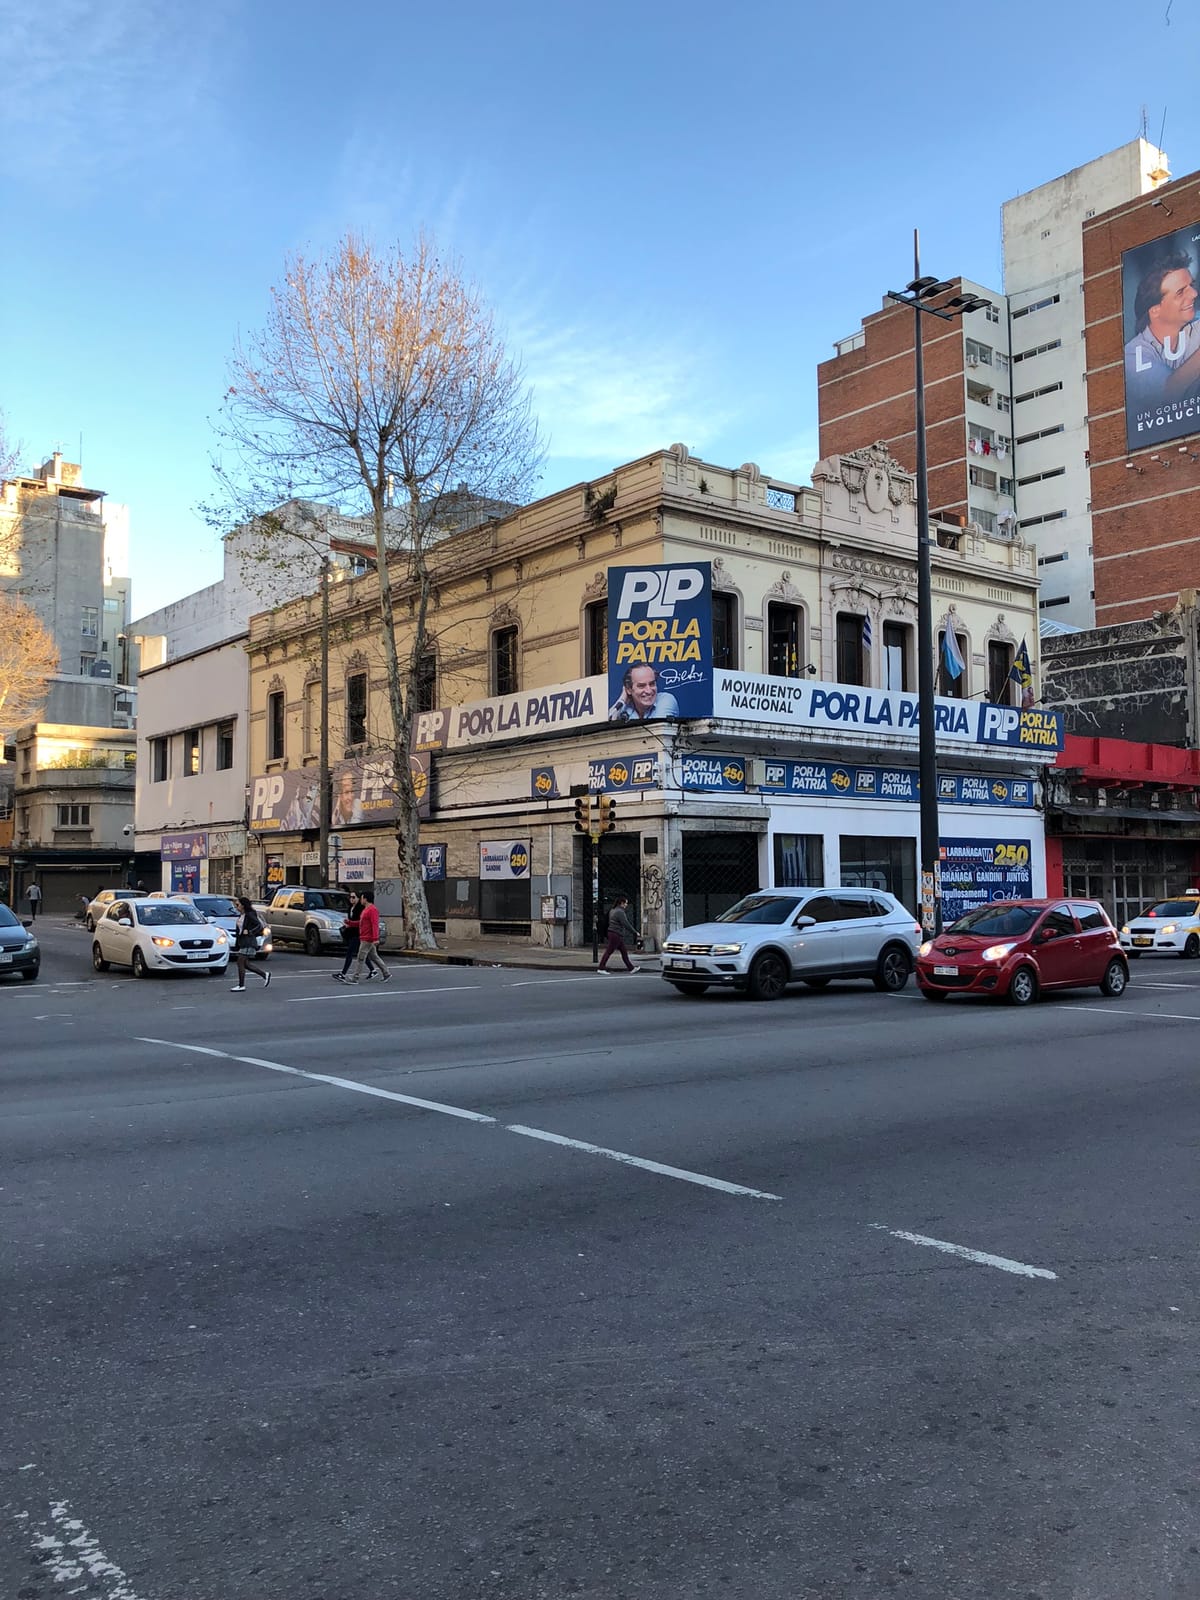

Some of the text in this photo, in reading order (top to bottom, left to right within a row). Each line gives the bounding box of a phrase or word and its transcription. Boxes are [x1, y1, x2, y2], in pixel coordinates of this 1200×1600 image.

[1137, 411, 1151, 421] UN
[1137, 405, 1200, 431] EVOLUCI
[617, 618, 701, 642] POR LA
[616, 640, 702, 664] PATRIA
[721, 678, 802, 700] MOVIMIENTO
[731, 695, 794, 714] NACIONAL
[809, 689, 969, 734] POR LA PARIA
[458, 687, 594, 738] POR LA PATRIA
[1020, 711, 1058, 730] POR LA
[1020, 727, 1058, 746] PATRIA
[595, 764, 606, 775] LA
[684, 759, 722, 772] POR LA
[793, 765, 826, 778] POR LA
[608, 767, 628, 781] 250
[683, 771, 723, 786] PATRIA
[723, 766, 744, 782] 250
[831, 772, 850, 788] 250
[882, 772, 899, 783] POR
[899, 773, 911, 785] LA
[535, 775, 552, 790] 250
[791, 777, 827, 791] PATRIA
[881, 783, 912, 796] PATRIA
[962, 778, 988, 789] POR LA
[961, 788, 990, 800] PATRIA
[991, 784, 1008, 797] 250
[947, 846, 982, 857] LARRAÑAGA
[994, 844, 1029, 867] 250
[511, 854, 528, 867] 250
[267, 867, 284, 881] 250
[976, 871, 1003, 882] GANDINI
[1006, 871, 1030, 882] JUNTOS
